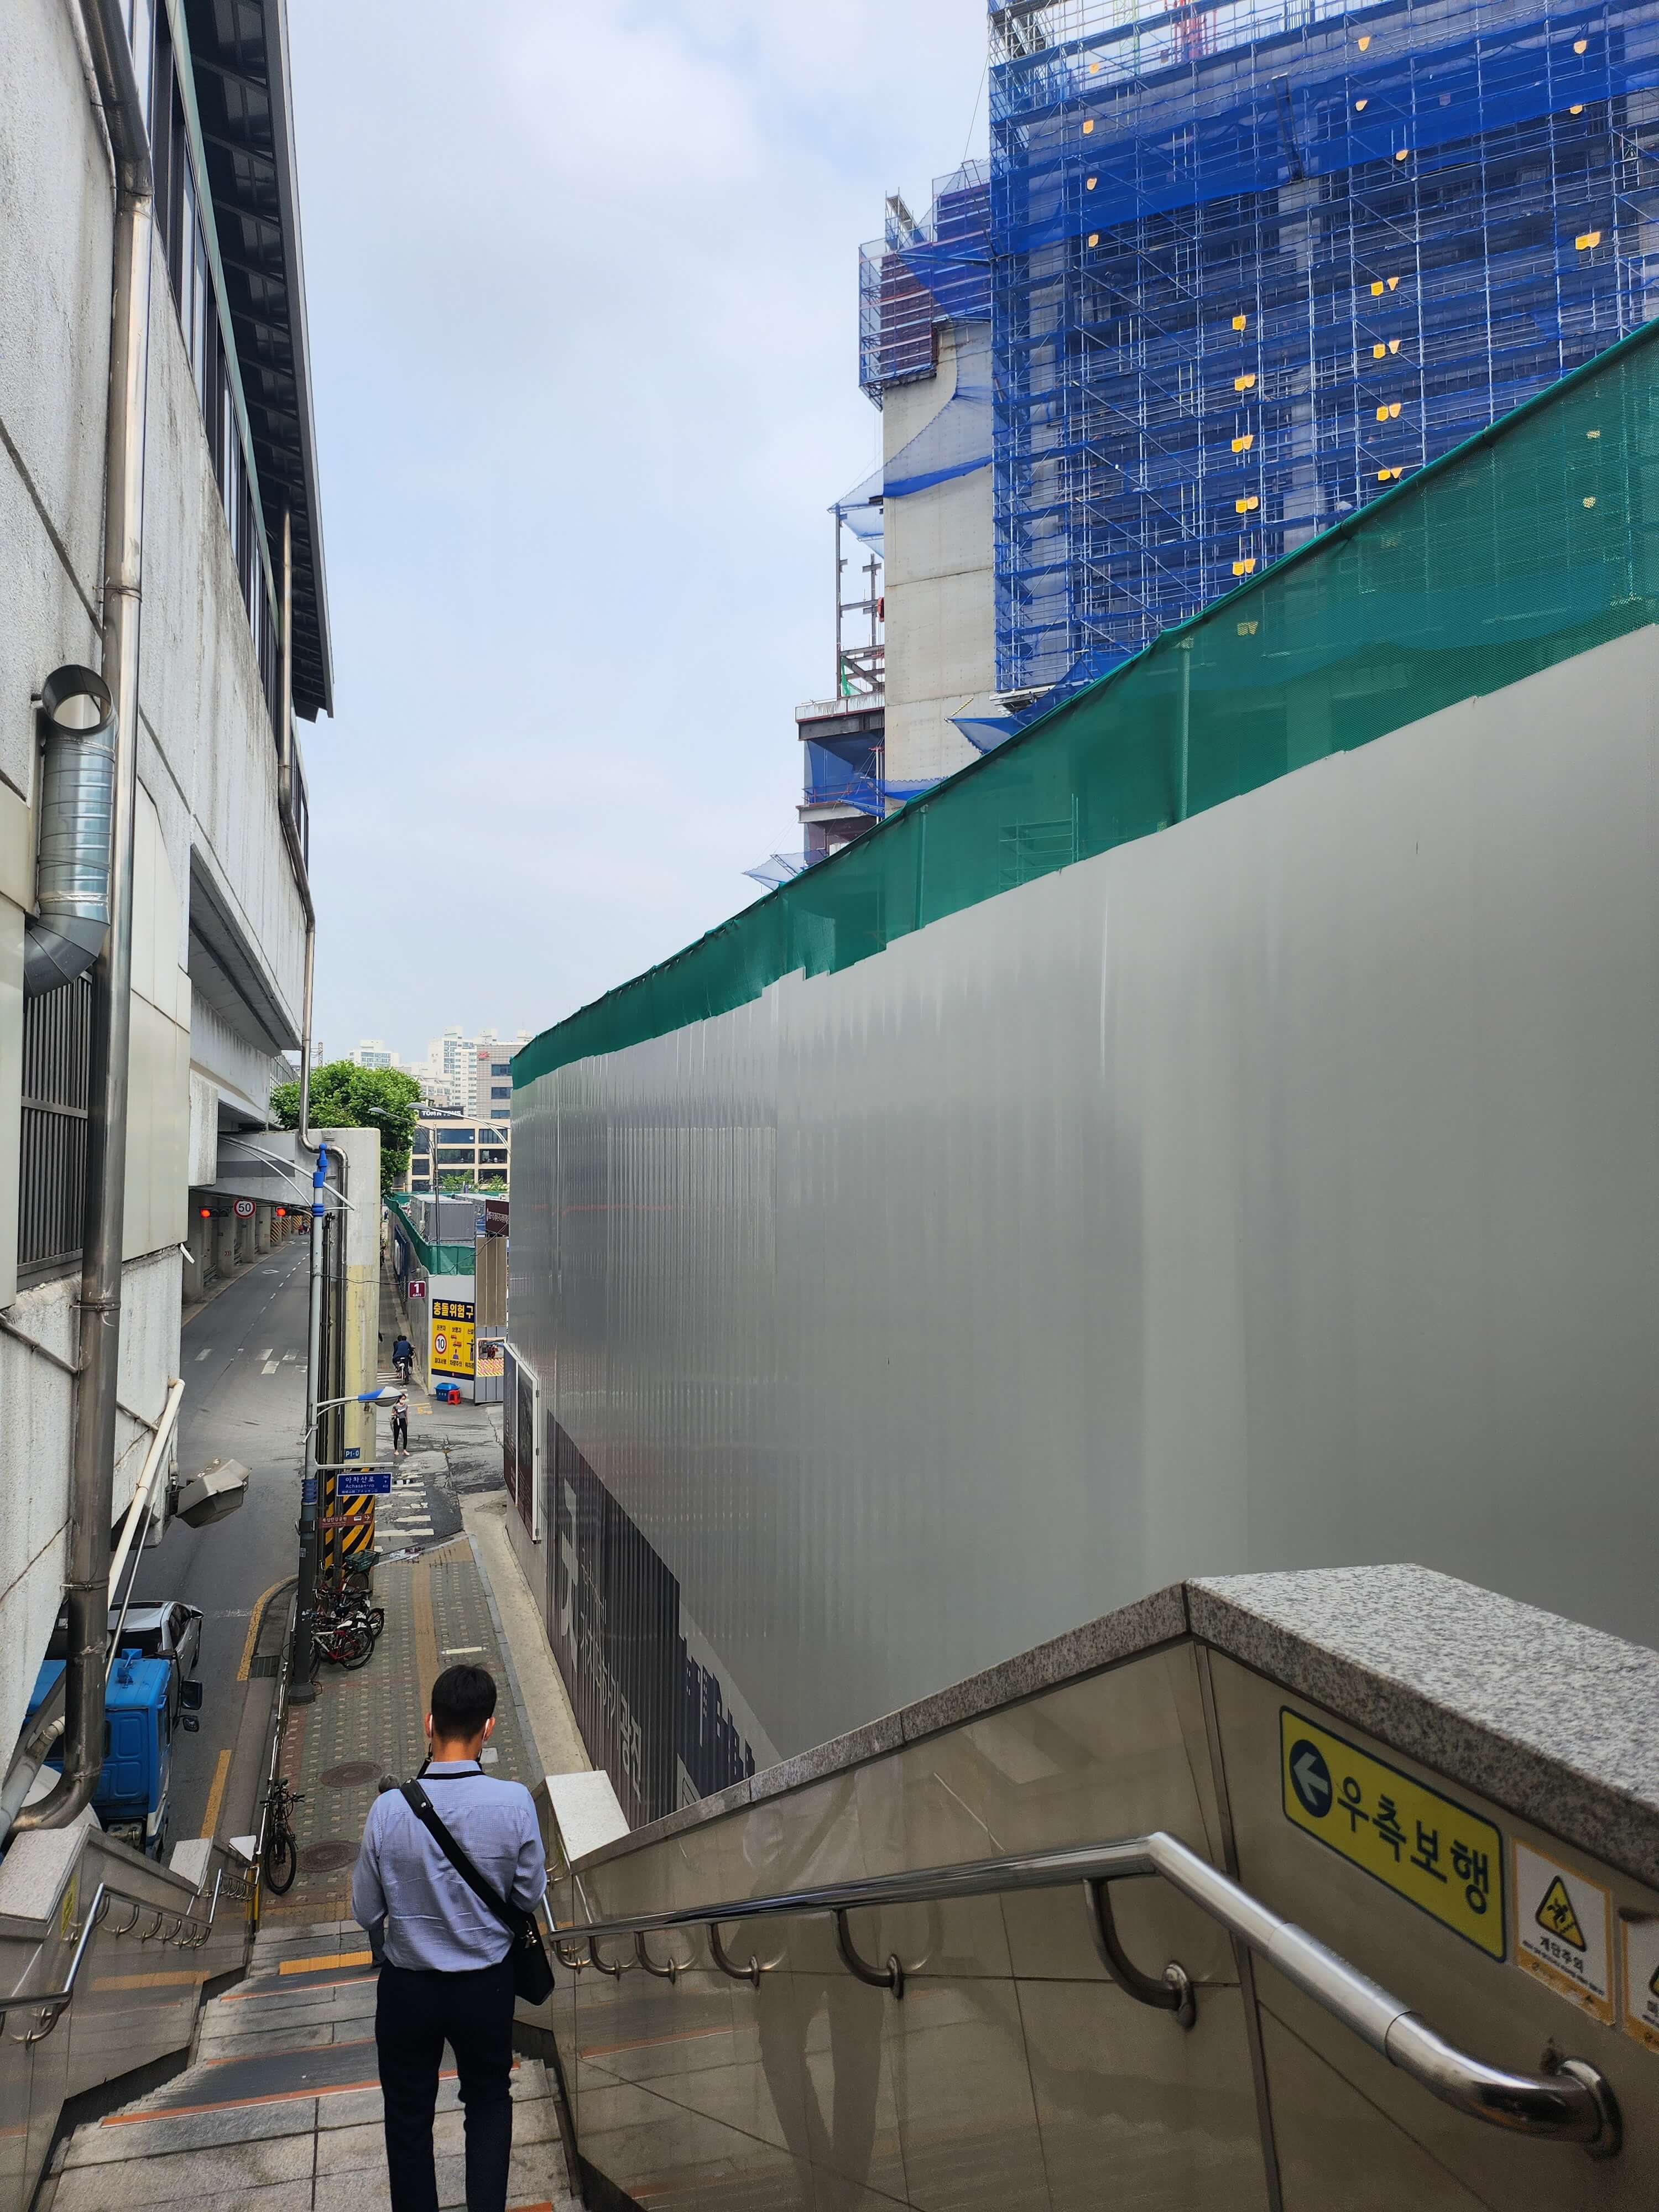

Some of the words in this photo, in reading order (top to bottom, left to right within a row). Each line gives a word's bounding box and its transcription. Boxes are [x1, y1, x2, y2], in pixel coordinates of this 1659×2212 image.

[238, 1203, 251, 1212] 50
[414, 1284, 419, 1293] 1
[437, 1339, 445, 1349] 10
[620, 1693, 641, 1803] 광진
[1336, 1775, 1490, 1916] 우측보행
